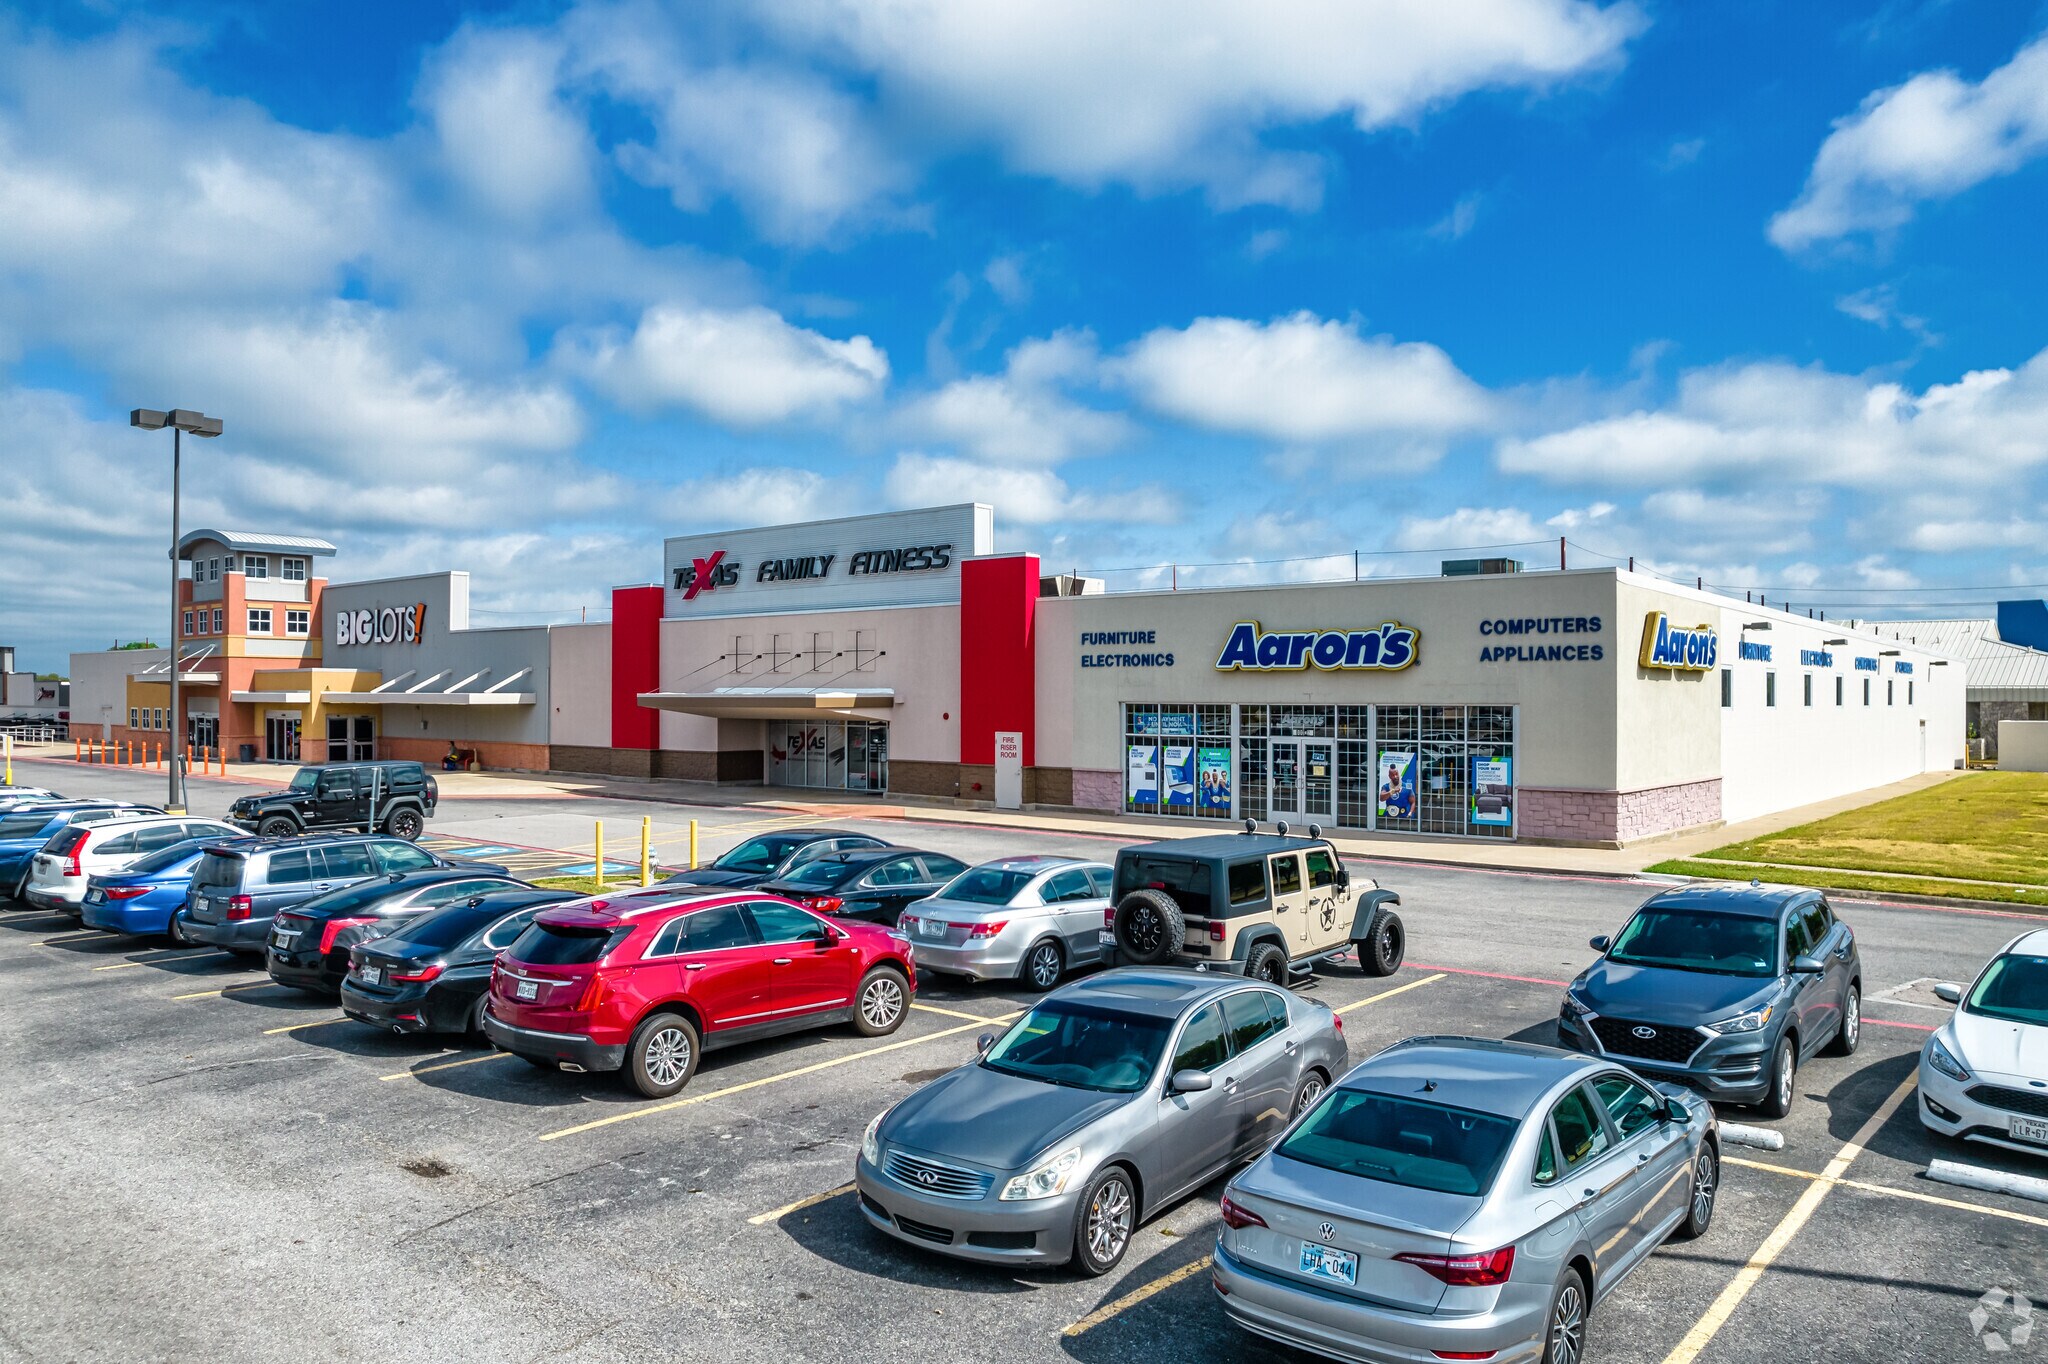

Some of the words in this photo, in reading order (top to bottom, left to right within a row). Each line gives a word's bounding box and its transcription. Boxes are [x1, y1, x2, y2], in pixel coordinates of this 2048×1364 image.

[673, 551, 740, 601] TEXAS
[757, 554, 836, 583] FAMILY
[849, 545, 952, 576] FITNESS
[1480, 616, 1602, 635] COMPUTERS
[1081, 630, 1156, 646] FURNITURE
[1215, 621, 1416, 669] Aaron's
[1650, 613, 1718, 670] Aaron's
[1081, 652, 1175, 668] ELECTRONICS
[1480, 644, 1604, 662] APPLIANCES
[1000, 751, 1017, 759] ROOM
[2013, 1124, 2046, 1139] LLR-67
